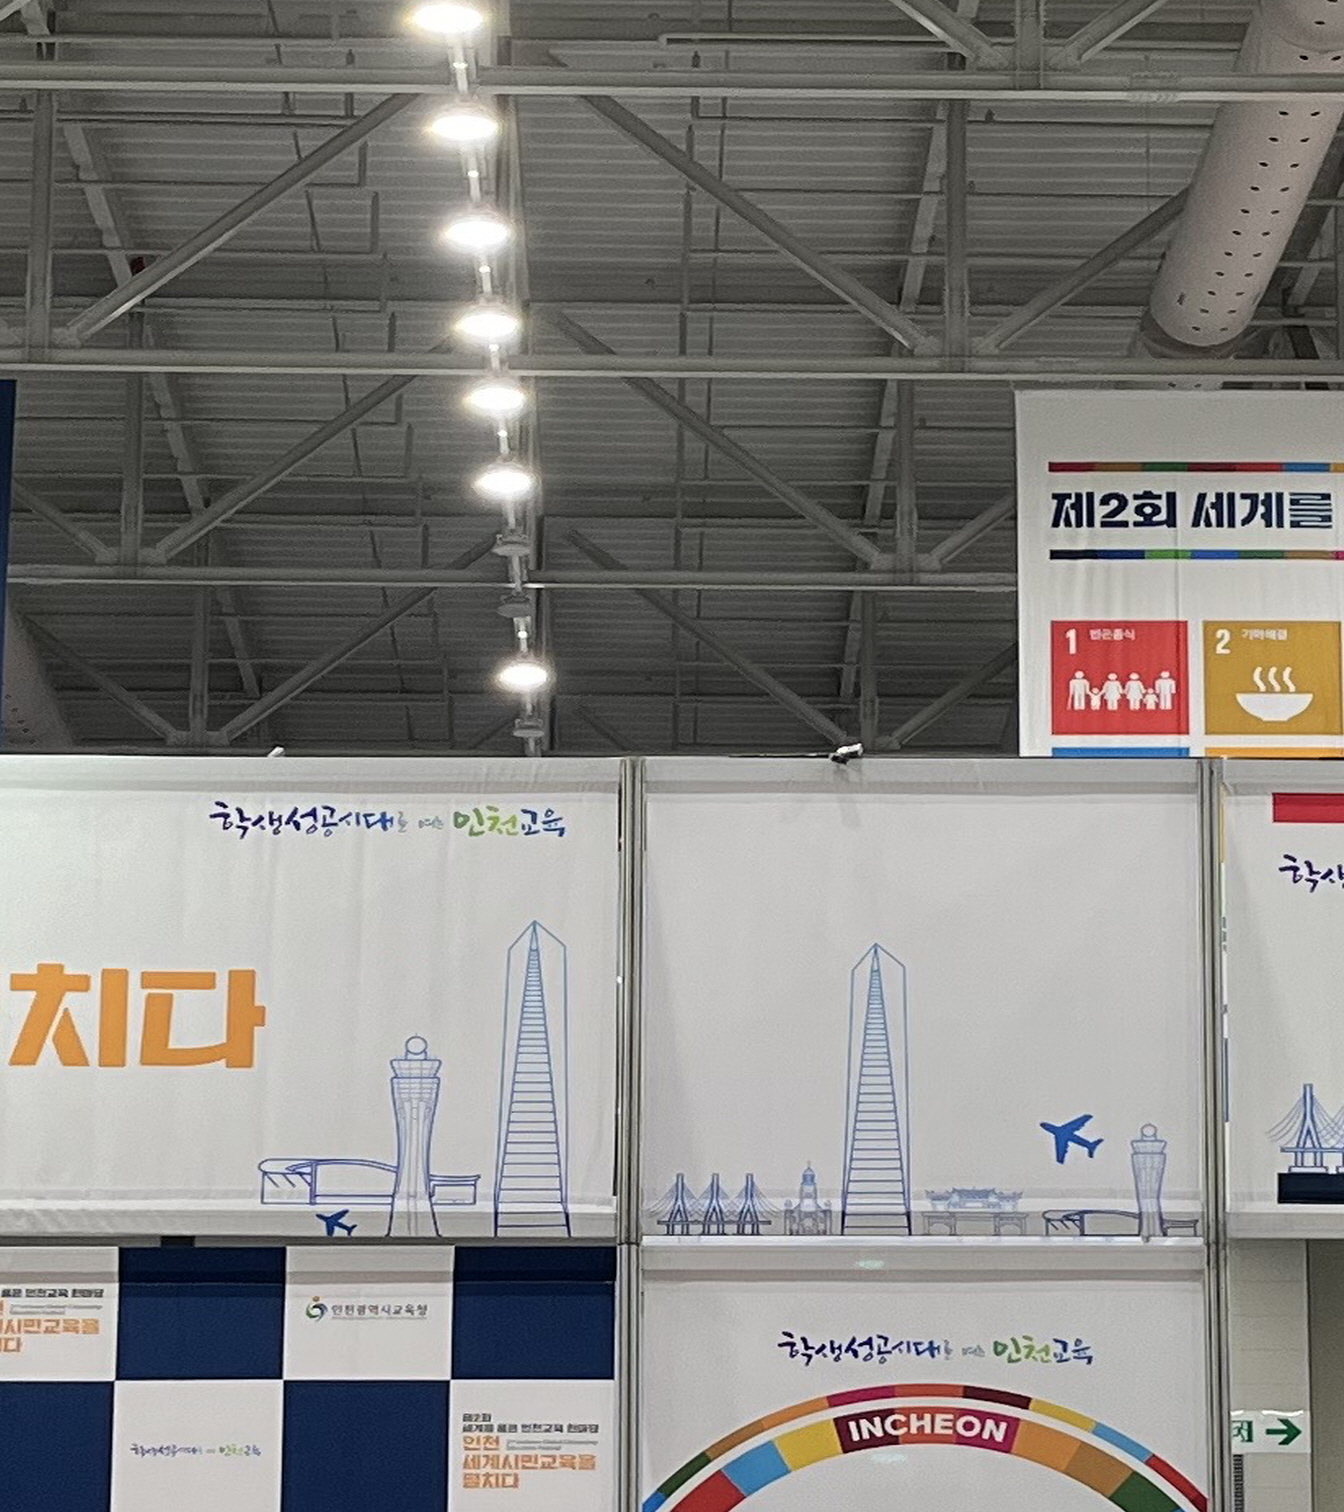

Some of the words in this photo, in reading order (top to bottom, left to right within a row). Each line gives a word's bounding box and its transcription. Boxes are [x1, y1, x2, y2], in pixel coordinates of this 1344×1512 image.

[1051, 491, 1177, 529] 제2회
[1191, 491, 1333, 530] 세계를
[1065, 629, 1077, 655] 1
[1215, 629, 1231, 655] 2
[453, 805, 567, 838] 인천교육
[9, 963, 266, 1068] 치다
[0, 1318, 100, 1335] 시민교육을
[992, 1336, 1094, 1365] 인천교육
[848, 1413, 1008, 1442] INCHEON
[463, 1435, 500, 1451] 인천
